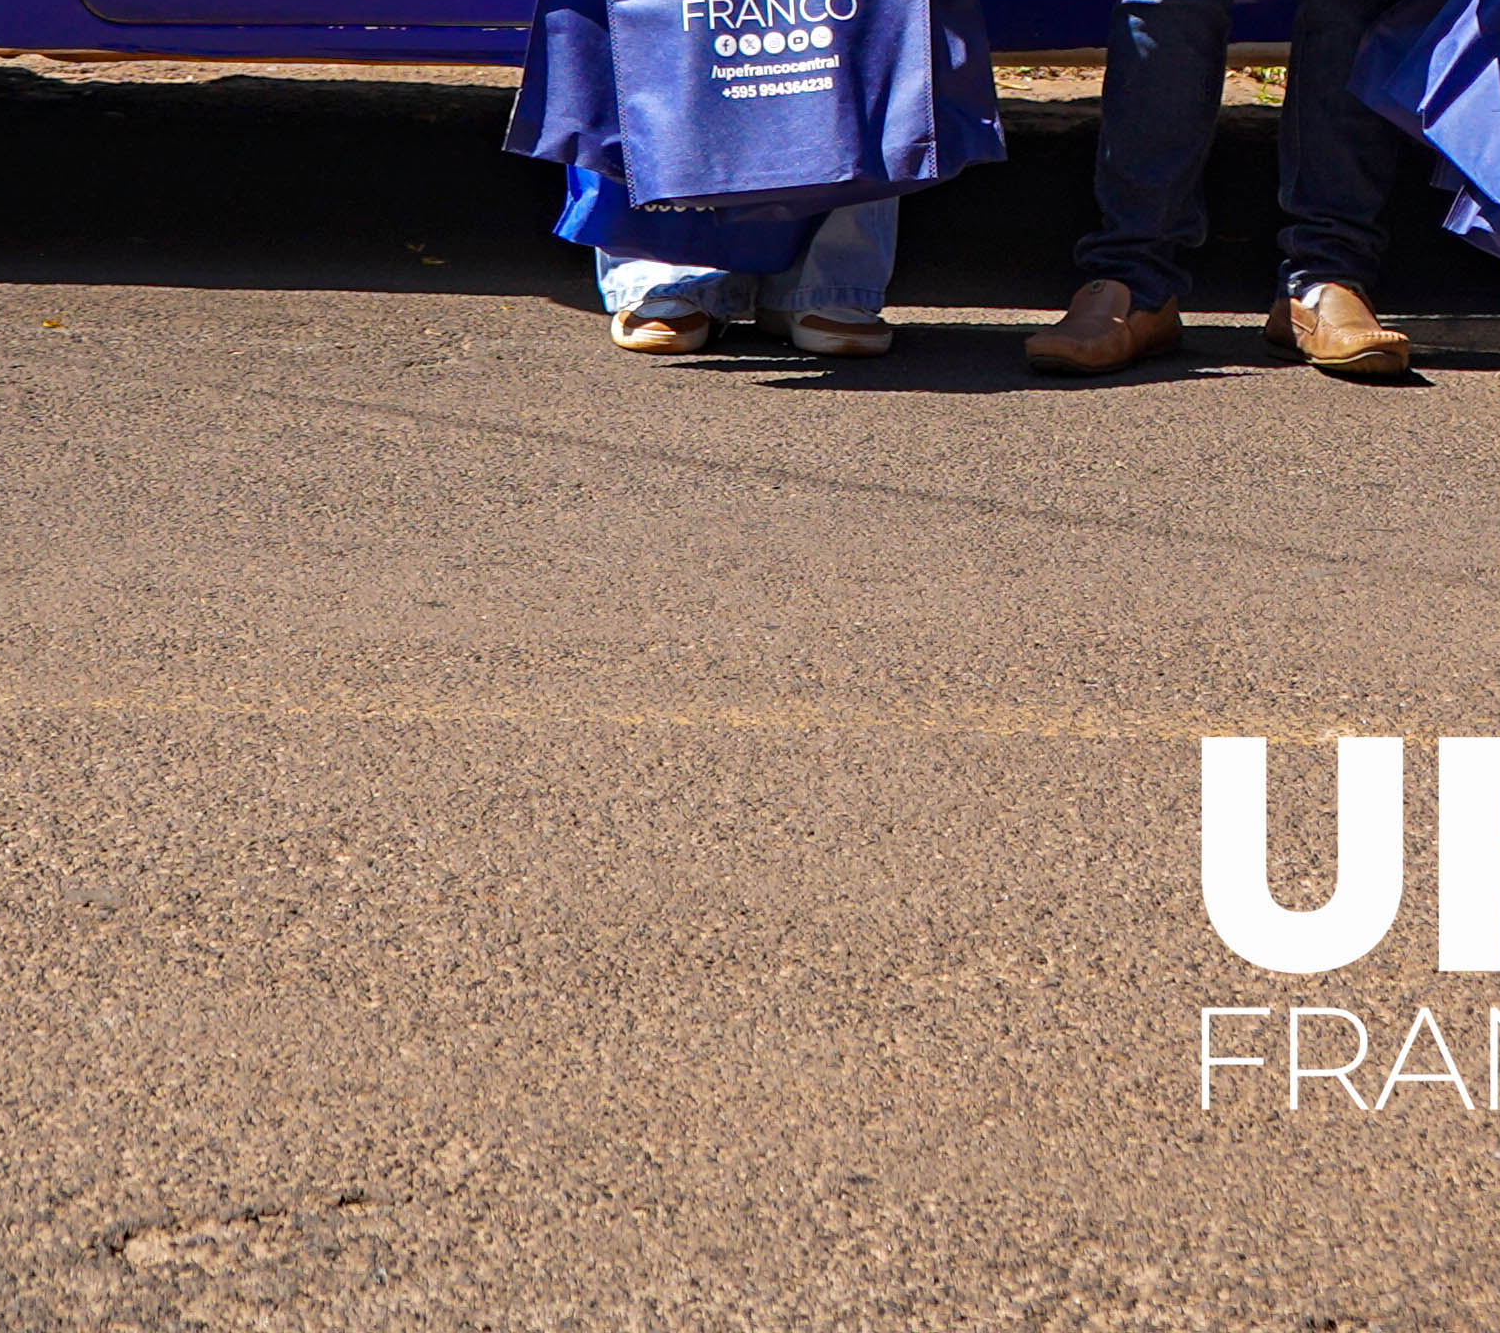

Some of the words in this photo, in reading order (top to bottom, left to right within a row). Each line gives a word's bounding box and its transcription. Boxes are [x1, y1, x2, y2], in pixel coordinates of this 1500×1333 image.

[711, 54, 840, 81] /upefrancocentral
[721, 84, 758, 100] +595
[758, 76, 833, 98] 994364238
